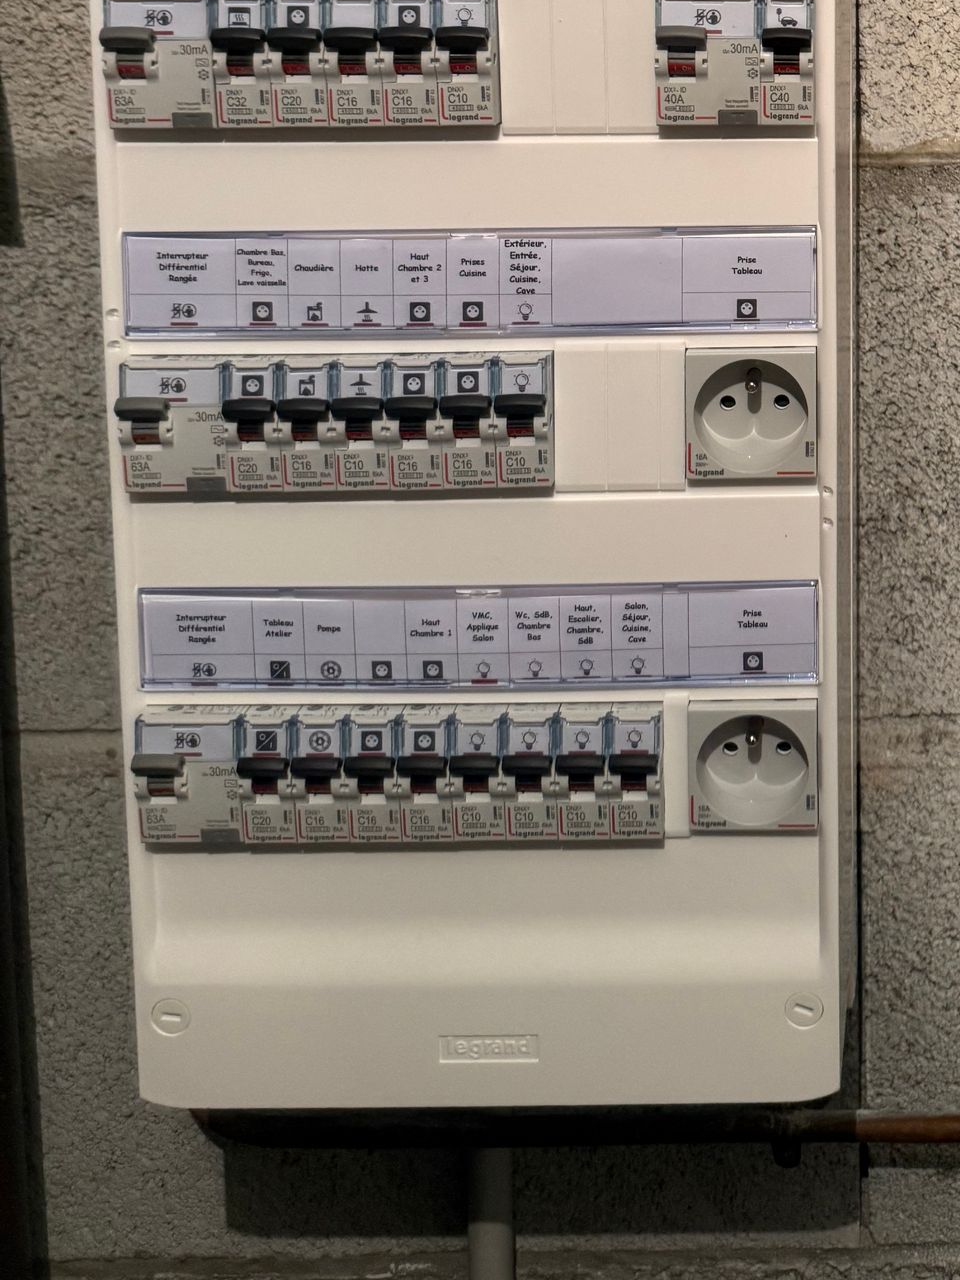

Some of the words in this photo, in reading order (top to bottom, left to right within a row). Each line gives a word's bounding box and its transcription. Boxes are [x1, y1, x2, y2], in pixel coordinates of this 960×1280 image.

[180, 45, 208, 55] 30mA
[730, 43, 758, 54] 30mA
[114, 96, 135, 106] 63A
[281, 96, 301, 106] C20
[337, 97, 357, 106] C16
[392, 97, 412, 106] C16
[447, 94, 468, 104] C10
[664, 94, 685, 104] 40A
[770, 93, 789, 102] C40
[227, 97, 247, 107] C32
[228, 117, 258, 125] legrand
[282, 116, 312, 124] legrand
[338, 117, 368, 125] legrand
[393, 116, 423, 124] legrand
[448, 114, 479, 122] legrand
[664, 114, 694, 122] legrand
[770, 113, 799, 121] legrand
[504, 240, 547, 248] Extérieur,
[156, 252, 209, 261] Interrupteur
[271, 249, 286, 257] Bas,
[510, 252, 541, 260] Entrée,
[248, 259, 275, 267] Bureau,
[461, 258, 485, 266] Prises
[737, 256, 757, 264] Prise
[159, 263, 207, 271] Différentiel
[294, 263, 334, 272] Chaudière
[398, 264, 433, 272] Chambre
[510, 263, 541, 272] Séjour,
[732, 267, 763, 275] Tableau
[169, 275, 197, 284] Rangée
[509, 276, 541, 284] Cuisine,
[292, 461, 312, 470] C16
[344, 460, 364, 470] C10
[452, 460, 472, 469] C16
[506, 457, 526, 467] C10
[238, 464, 257, 473] C20
[398, 462, 418, 471] C16
[293, 480, 322, 488] legrand
[345, 480, 374, 488] legrand
[453, 478, 482, 486] legrand
[507, 476, 536, 484] legrand
[238, 483, 268, 491] legrand
[399, 481, 428, 489] legrand
[625, 602, 649, 610] Salon,
[176, 614, 227, 622] Interrupteur
[472, 611, 493, 620] VMC,
[568, 615, 602, 623] Escalier,
[622, 613, 651, 623] Séjour,
[263, 619, 294, 627] Tableau
[517, 622, 551, 630] Chambre
[179, 625, 225, 633] Différentiel
[317, 625, 341, 633] Pompe
[466, 623, 499, 632] Applique
[566, 626, 604, 634] Chambre,
[622, 624, 651, 632] Cuisine,
[265, 630, 292, 638] Atelier
[472, 634, 494, 642] Salon
[527, 633, 541, 641] Bas
[189, 636, 216, 644] Rangée
[462, 813, 481, 822] C10
[514, 813, 534, 822] C10
[566, 812, 585, 821] C10
[618, 811, 638, 820] C10
[252, 816, 271, 826] C20
[697, 820, 726, 828] legrand
[462, 830, 491, 838] legrand
[515, 830, 543, 838] legrand
[619, 829, 647, 837] legrand
[306, 834, 335, 842] legrand
[358, 834, 387, 842] legrand
[411, 834, 440, 842] legrand
